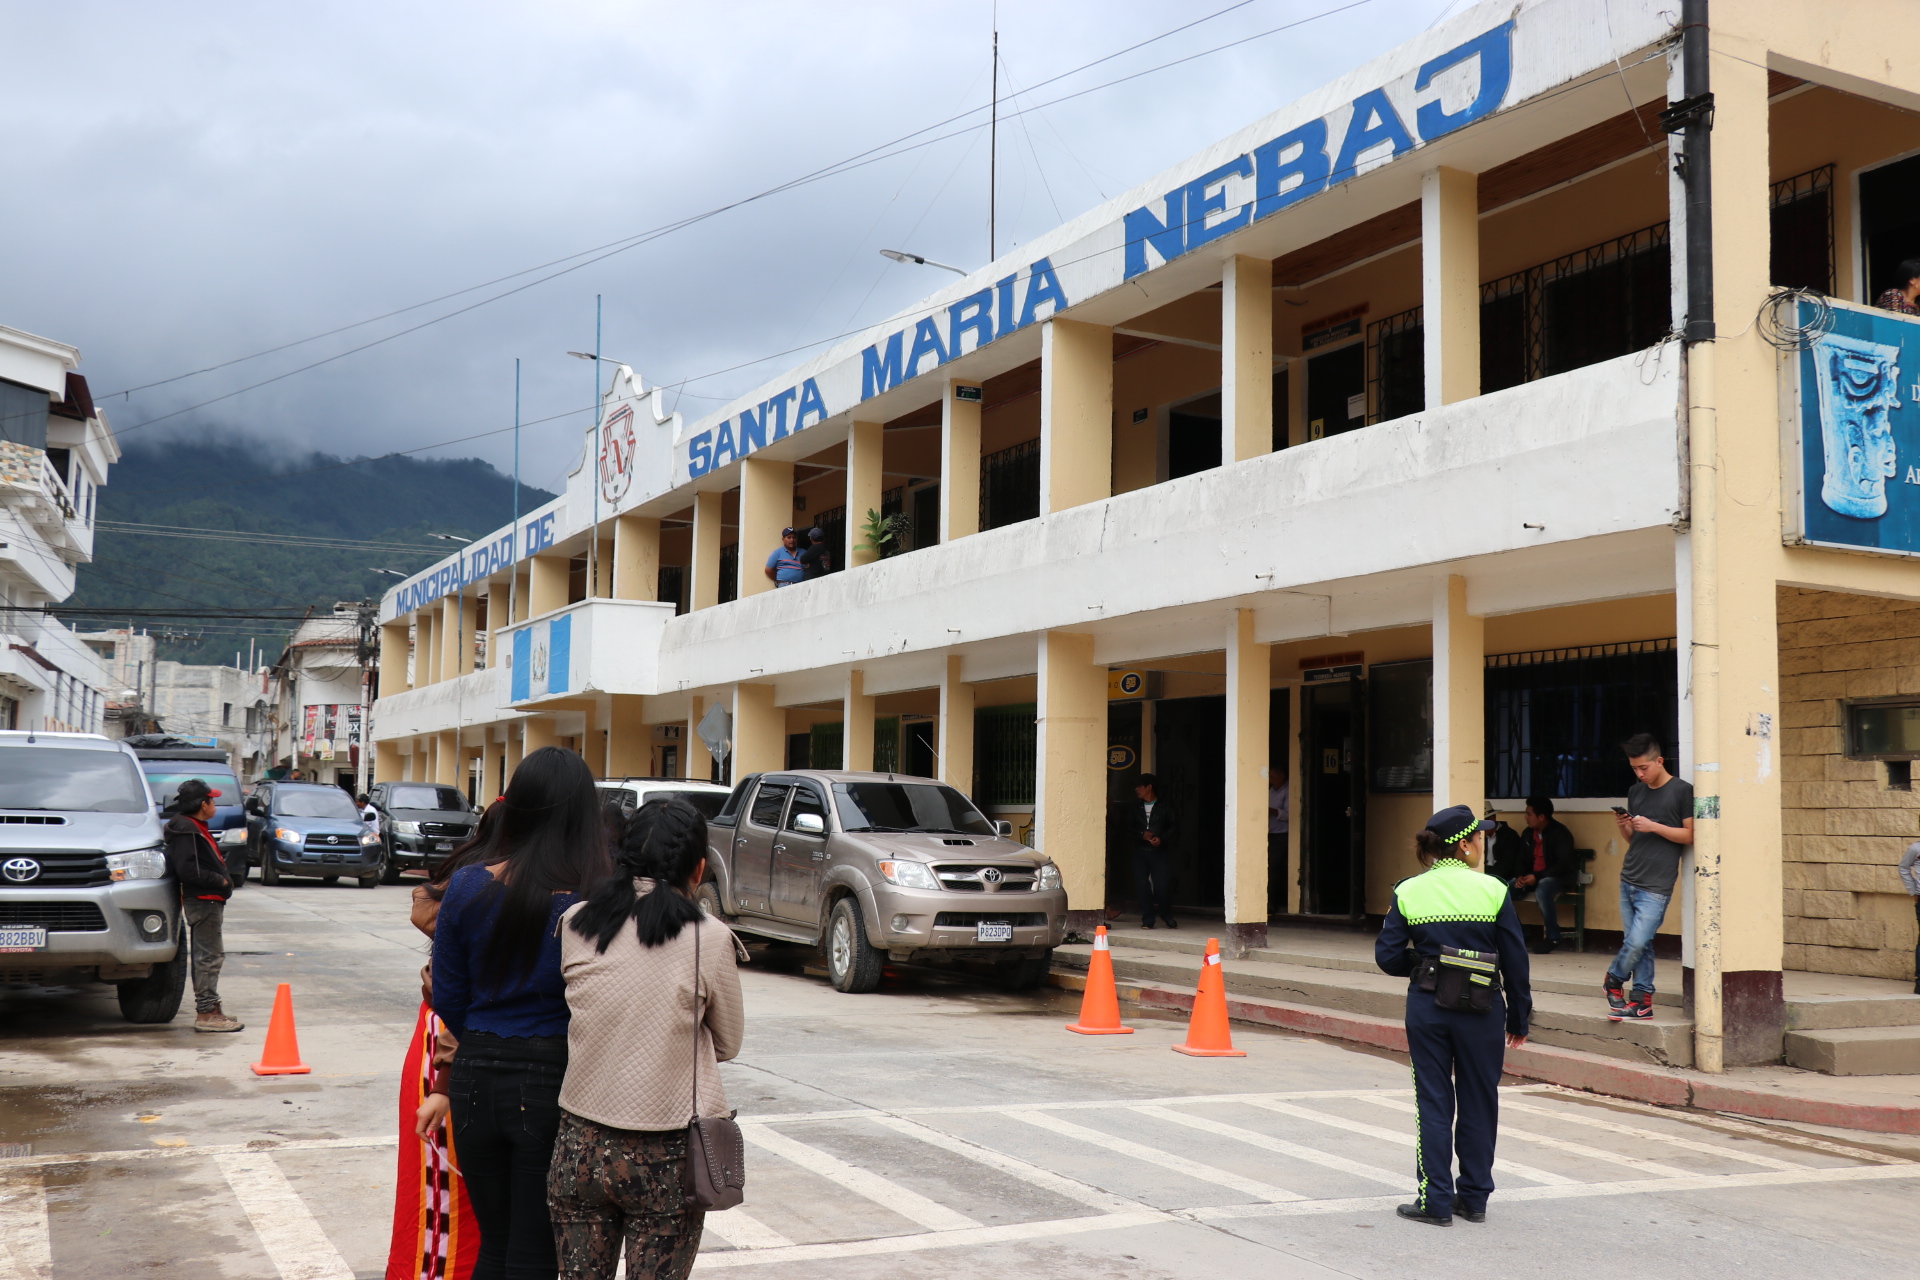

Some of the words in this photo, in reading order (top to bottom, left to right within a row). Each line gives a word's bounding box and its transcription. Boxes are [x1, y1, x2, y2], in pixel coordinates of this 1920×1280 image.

[396, 533, 514, 618] MUNICIPALIDAD
[525, 511, 556, 557] DE
[688, 377, 828, 479] SANTA
[860, 256, 1069, 402] MARIA
[1123, 18, 1517, 281] NEBAJ
[1314, 425, 1321, 439] 9
[1325, 754, 1337, 769] 16
